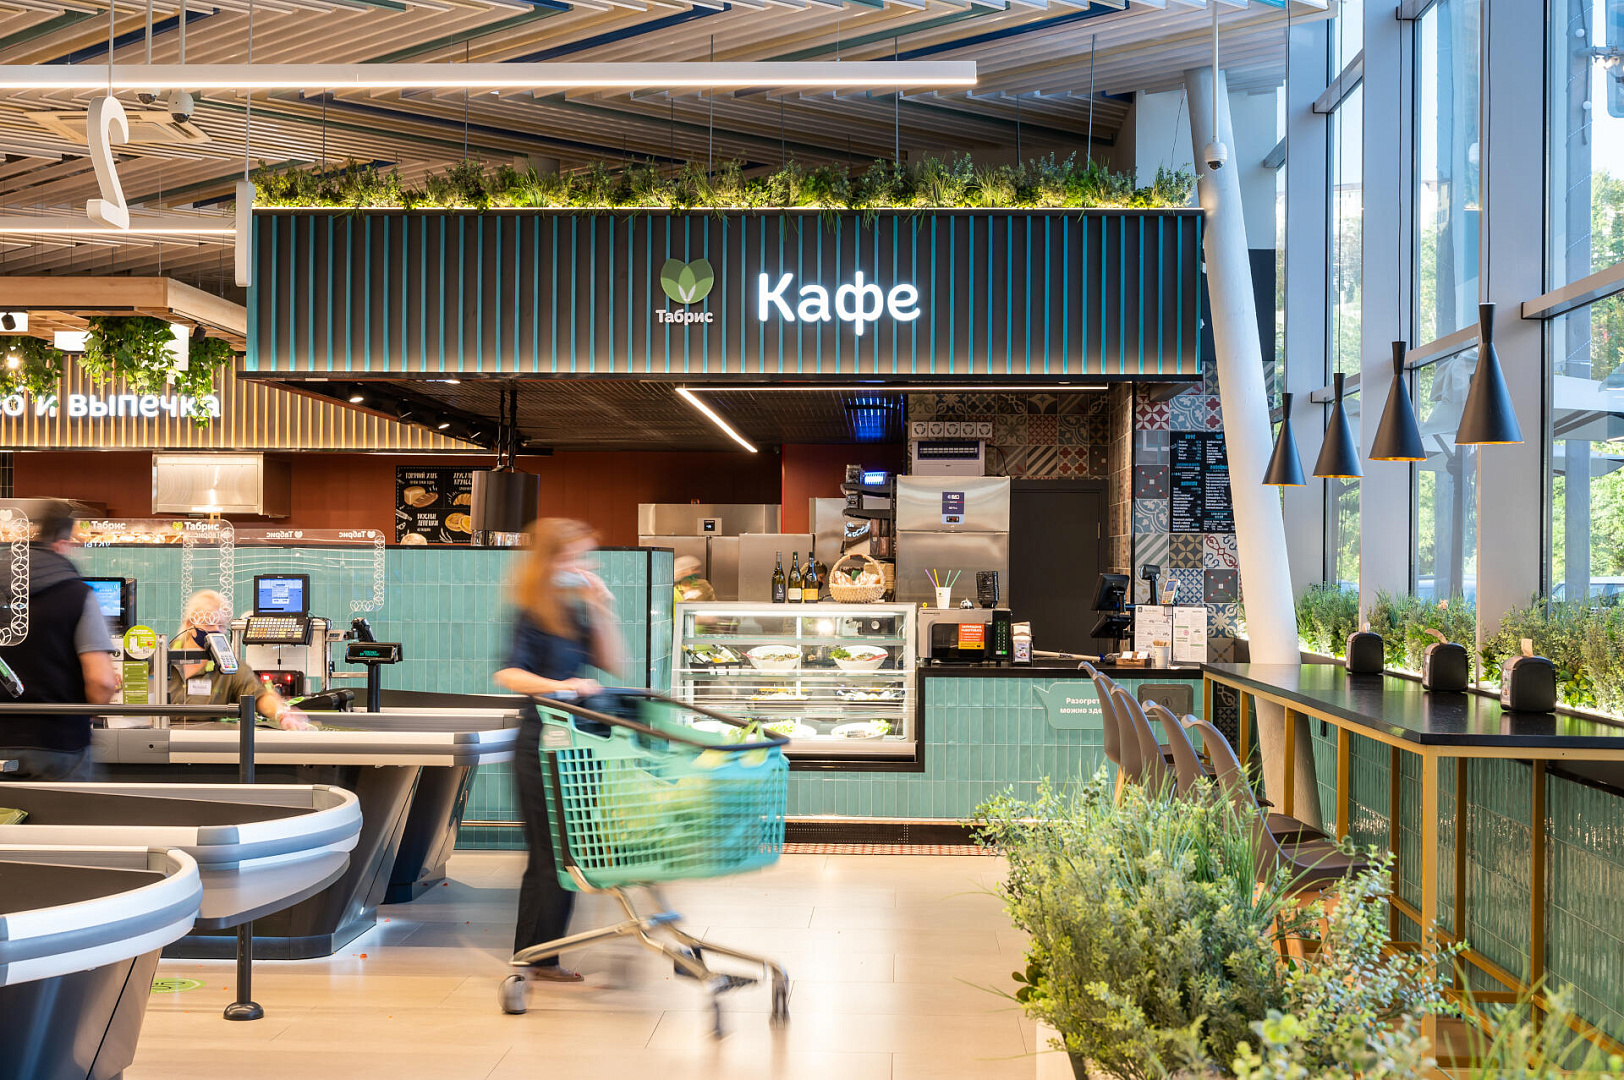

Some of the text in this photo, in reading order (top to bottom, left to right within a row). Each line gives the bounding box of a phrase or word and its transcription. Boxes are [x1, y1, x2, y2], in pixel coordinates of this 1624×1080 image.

[758, 271, 921, 336] Кафе
[655, 309, 714, 325] Табрис
[0, 394, 24, 417] о
[69, 394, 221, 418] выпечка
[91, 520, 126, 531] Табрис
[184, 521, 220, 532] Табрис
[1065, 697, 1100, 706] Разогрет
